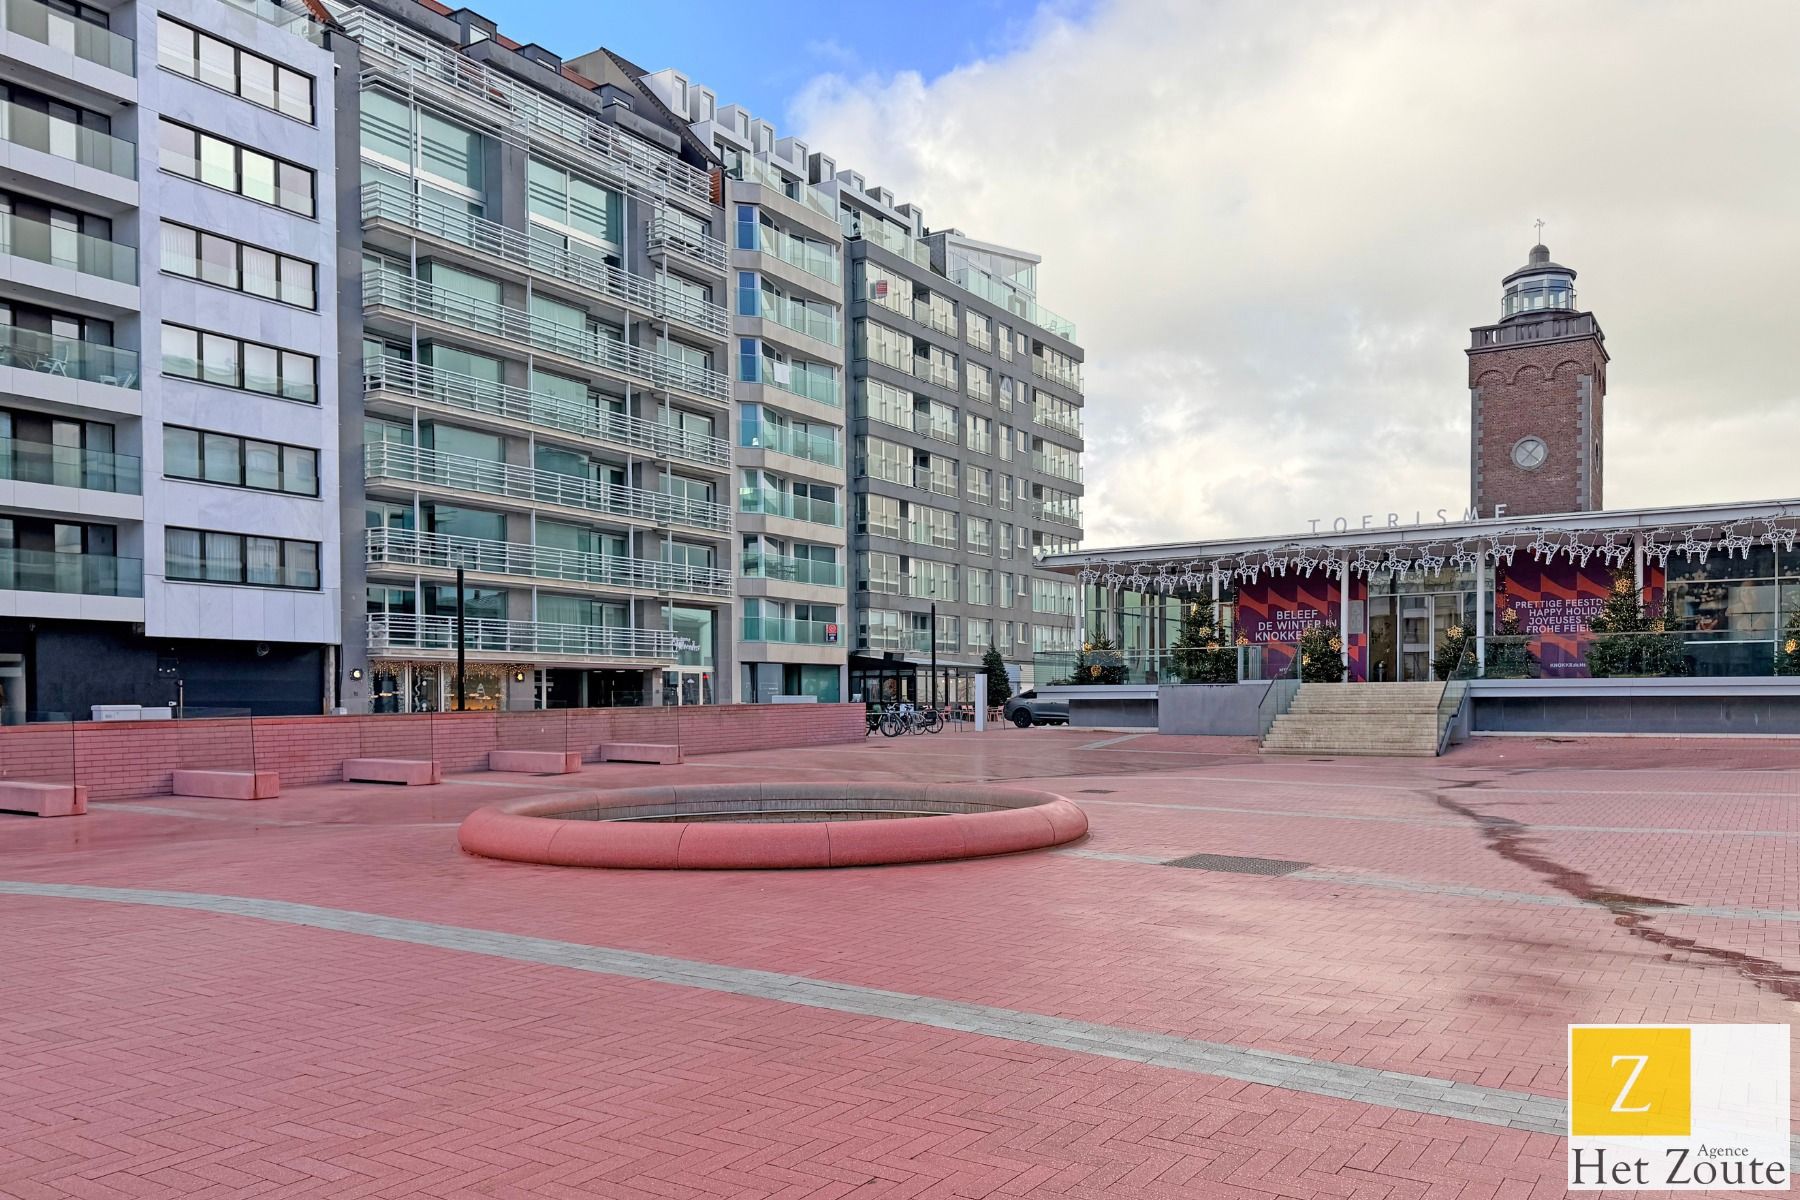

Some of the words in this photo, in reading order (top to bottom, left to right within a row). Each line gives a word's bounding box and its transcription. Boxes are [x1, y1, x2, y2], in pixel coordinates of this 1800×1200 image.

[1308, 504, 1507, 535] TOERISME
[1515, 599, 1564, 609] PRETTIGE
[1276, 609, 1318, 620] BELEEF
[1529, 608, 1563, 617] HAPPY
[1528, 616, 1581, 625] JOYEUSES
[1258, 621, 1273, 631] DE
[1526, 625, 1560, 634] FROHE
